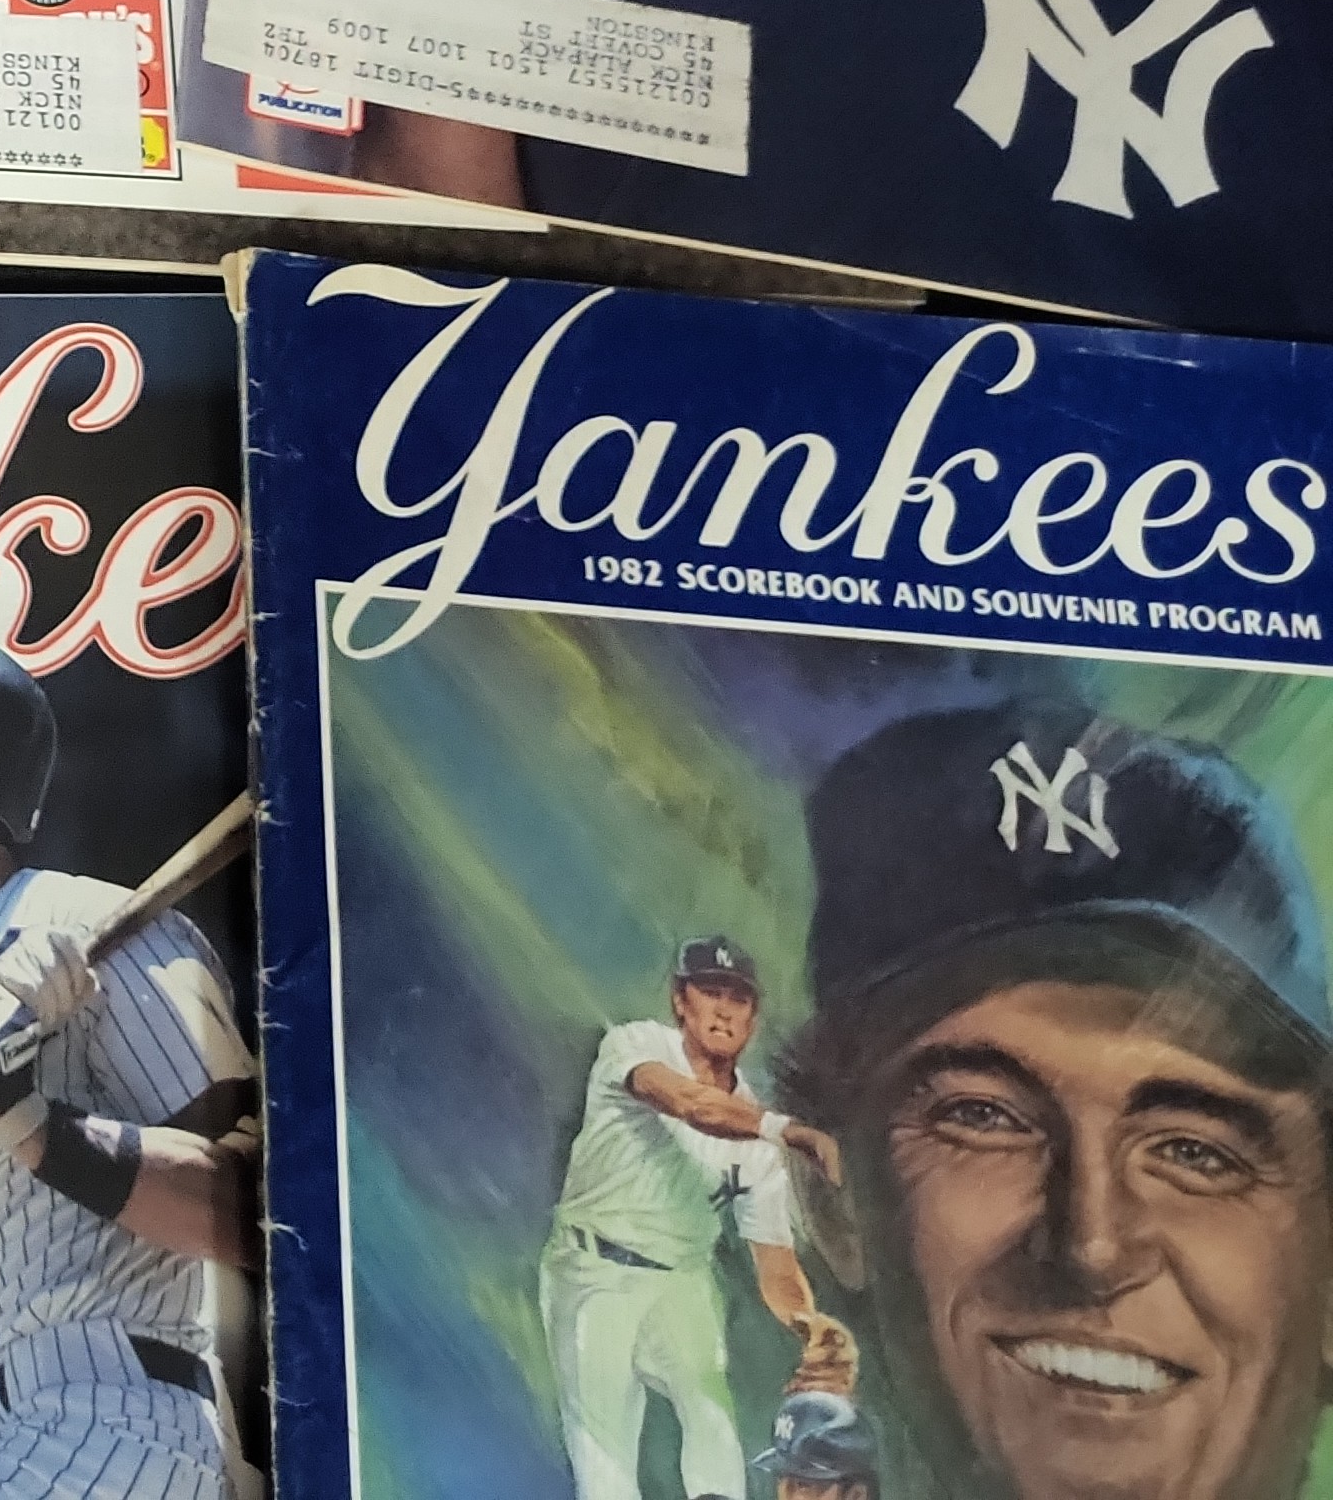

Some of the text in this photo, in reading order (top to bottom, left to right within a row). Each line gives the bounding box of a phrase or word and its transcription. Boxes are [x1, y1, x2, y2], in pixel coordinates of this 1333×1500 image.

[20, 89, 82, 110] NICK
[258, 93, 343, 120] PUBLICATION
[306, 263, 1329, 661] Yankees
[582, 555, 1323, 641] 1982 SCOREBOOK AND SOUVENIR PROGRAM
